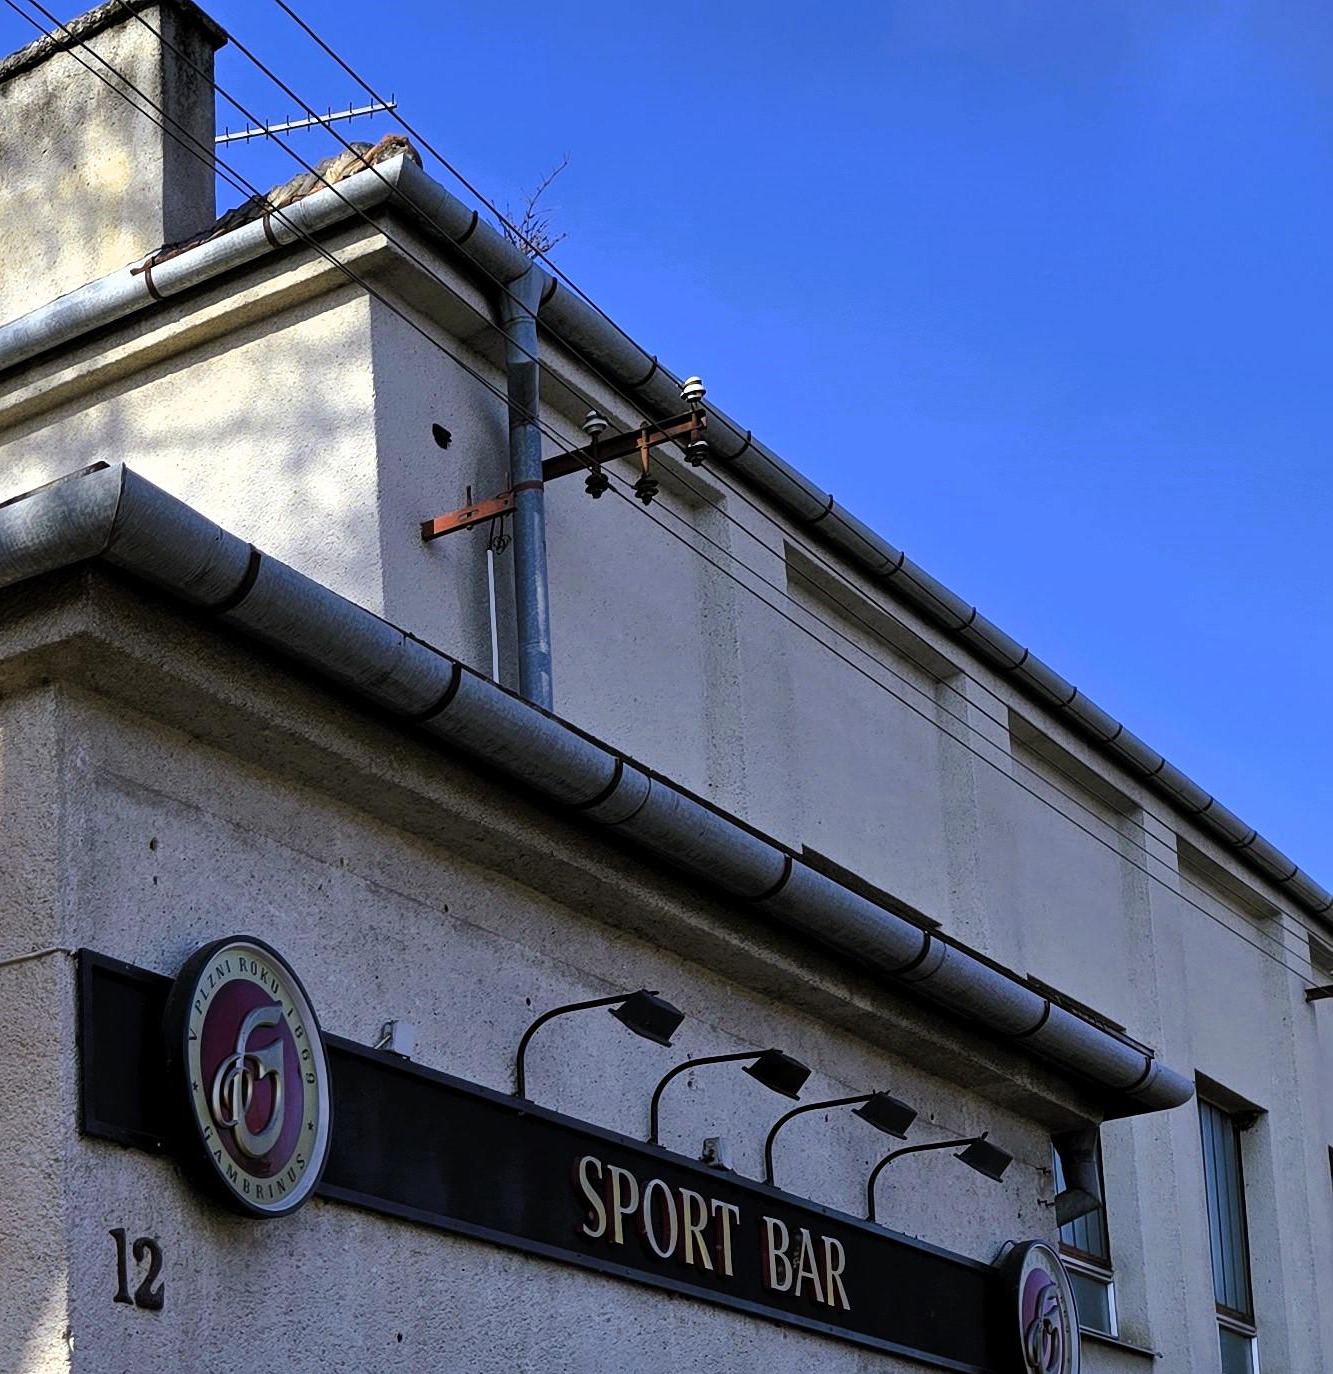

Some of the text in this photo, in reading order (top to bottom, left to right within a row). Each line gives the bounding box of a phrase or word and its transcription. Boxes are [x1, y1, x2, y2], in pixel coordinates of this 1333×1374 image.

[187, 956, 317, 1086] V PLZNI ROKU 1869
[202, 1123, 307, 1200] GAMBRINUS
[108, 1227, 164, 1311] 12
[577, 1155, 851, 1311] SPORT BAR
